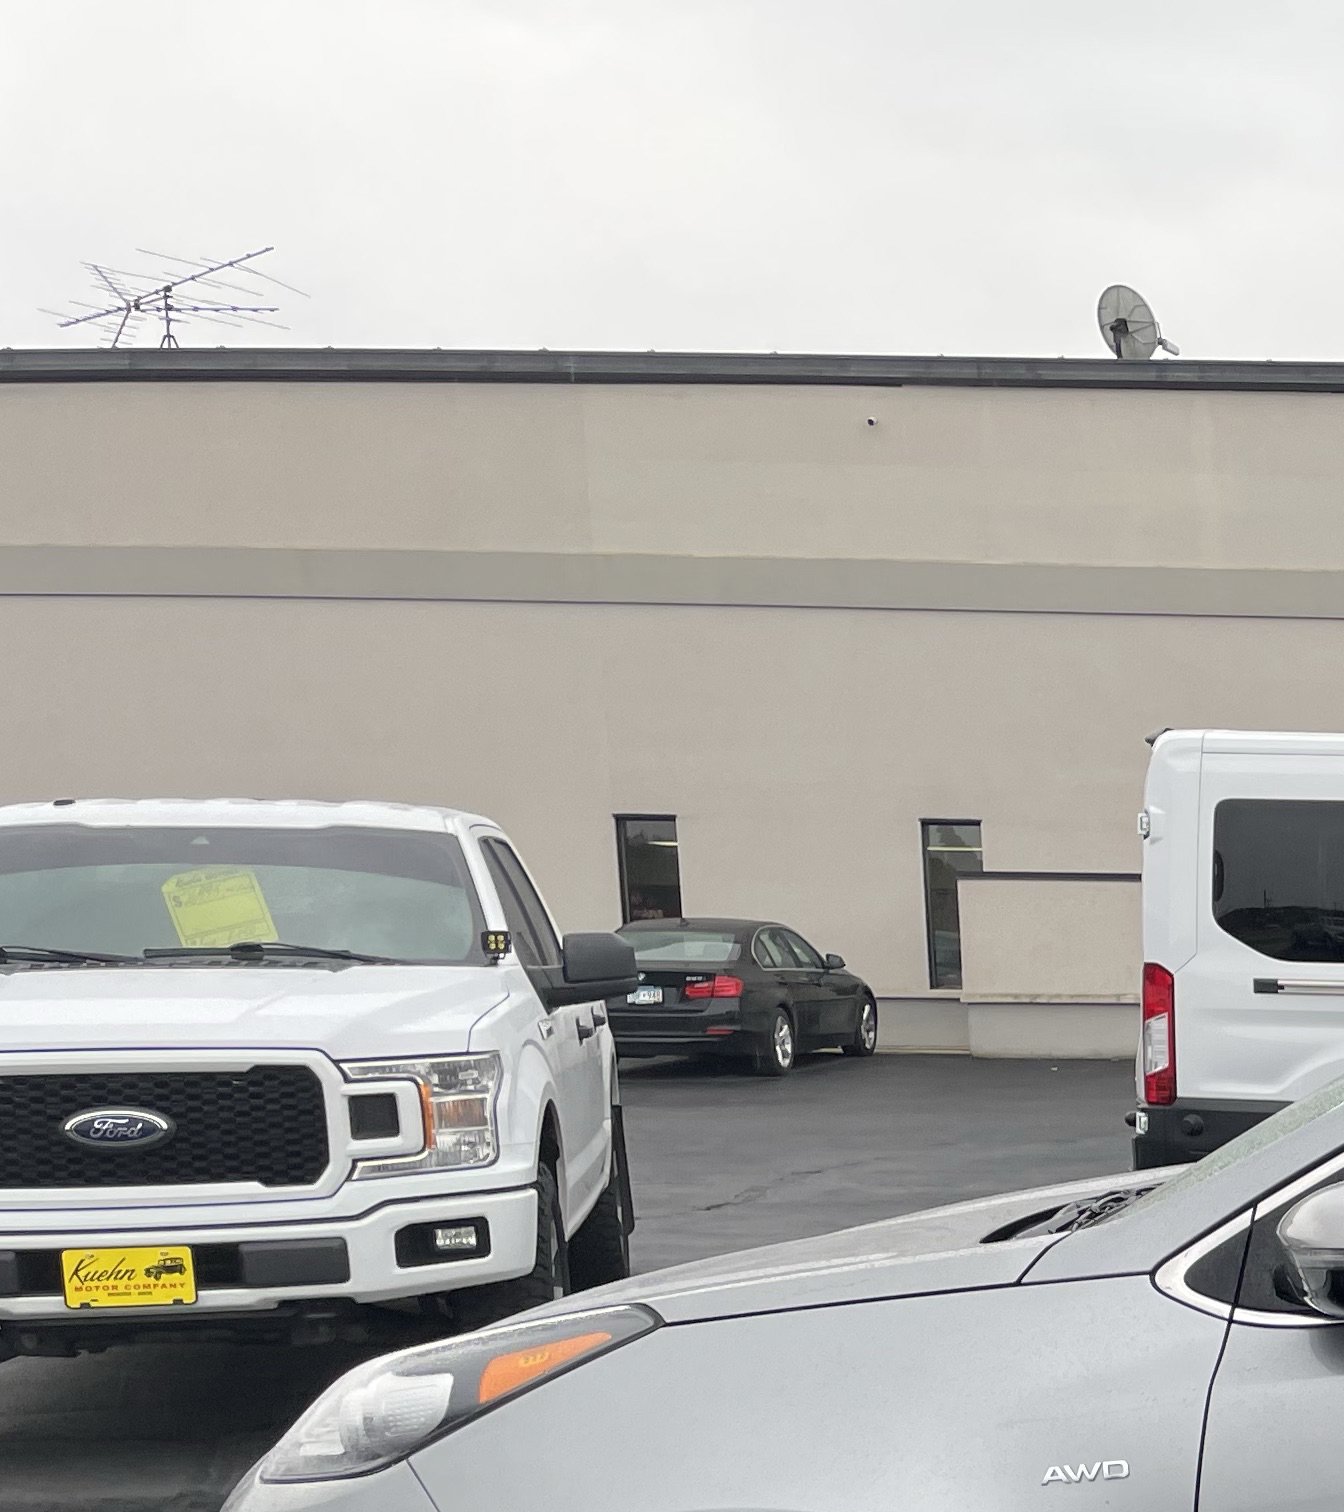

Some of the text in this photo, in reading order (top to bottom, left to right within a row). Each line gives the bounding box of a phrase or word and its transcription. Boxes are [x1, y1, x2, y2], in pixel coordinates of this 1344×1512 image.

[89, 1118, 144, 1139] Ford
[68, 1257, 138, 1285] Kuehn
[74, 1282, 186, 1292] MOTOR COMPANY
[1041, 1459, 1130, 1486] AWD
